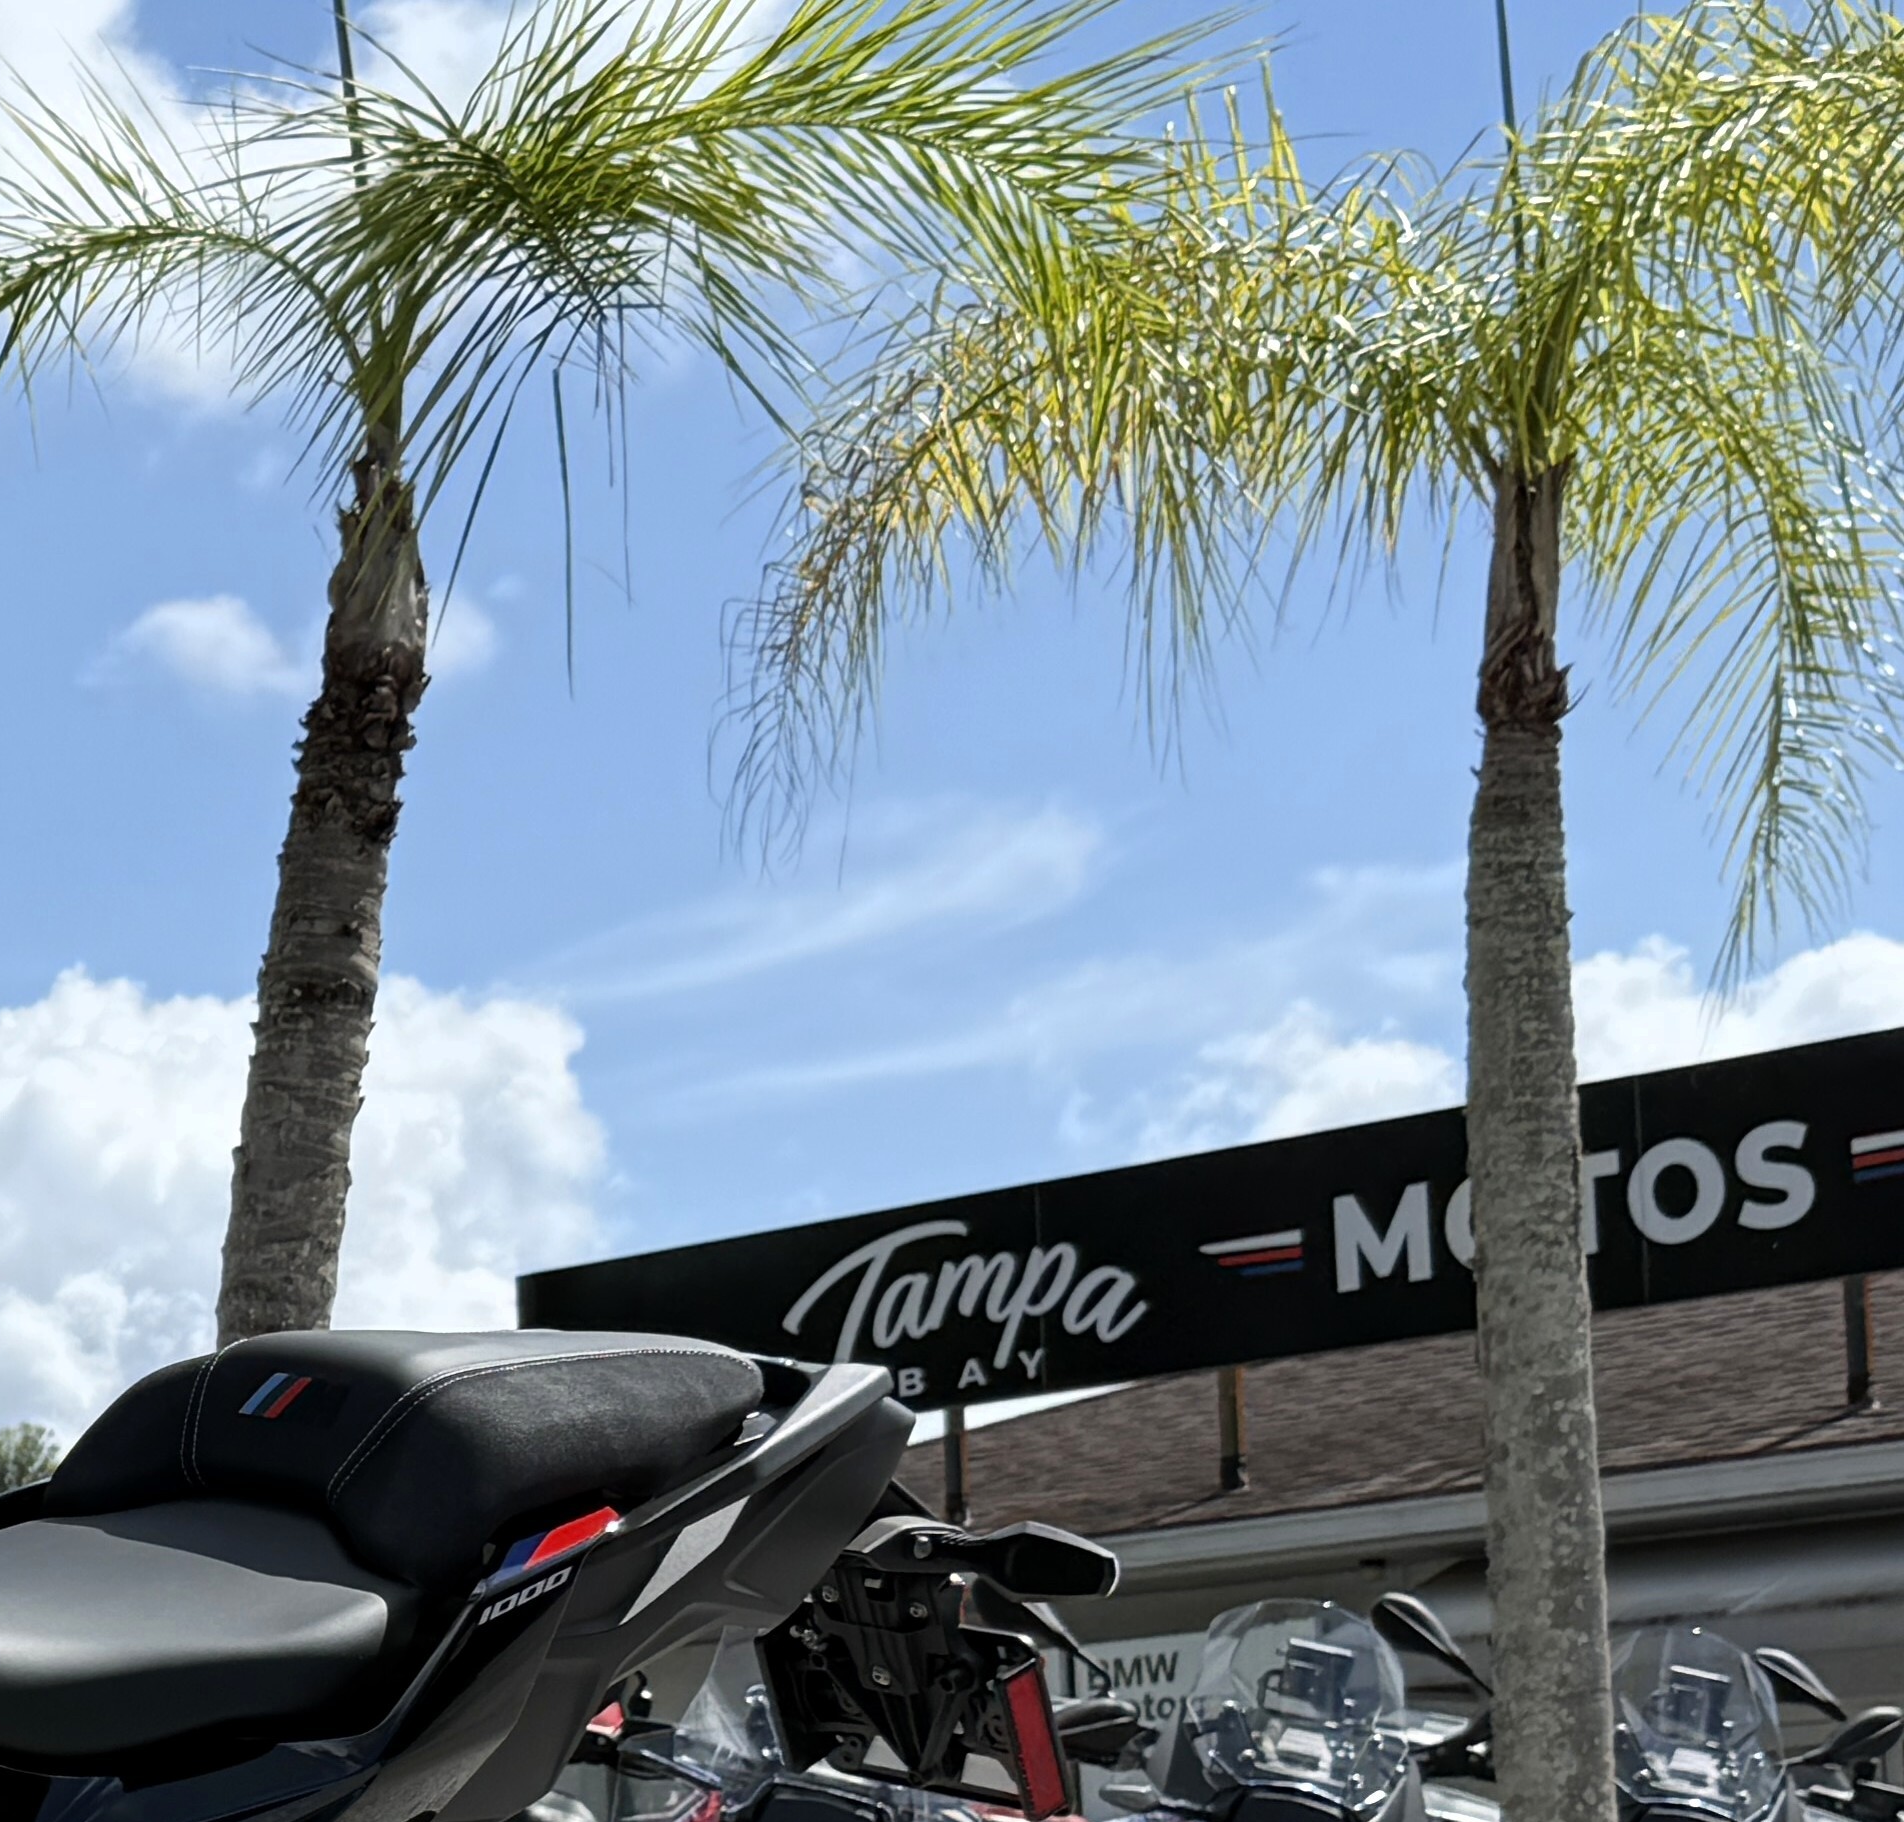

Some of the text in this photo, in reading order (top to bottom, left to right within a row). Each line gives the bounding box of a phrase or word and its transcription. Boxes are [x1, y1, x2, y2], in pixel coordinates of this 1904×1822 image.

[1332, 1120, 1816, 1294] MTOS
[782, 1220, 1148, 1369] Tampa
[898, 1347, 1046, 1397] BAY
[478, 1566, 572, 1626] 1000
